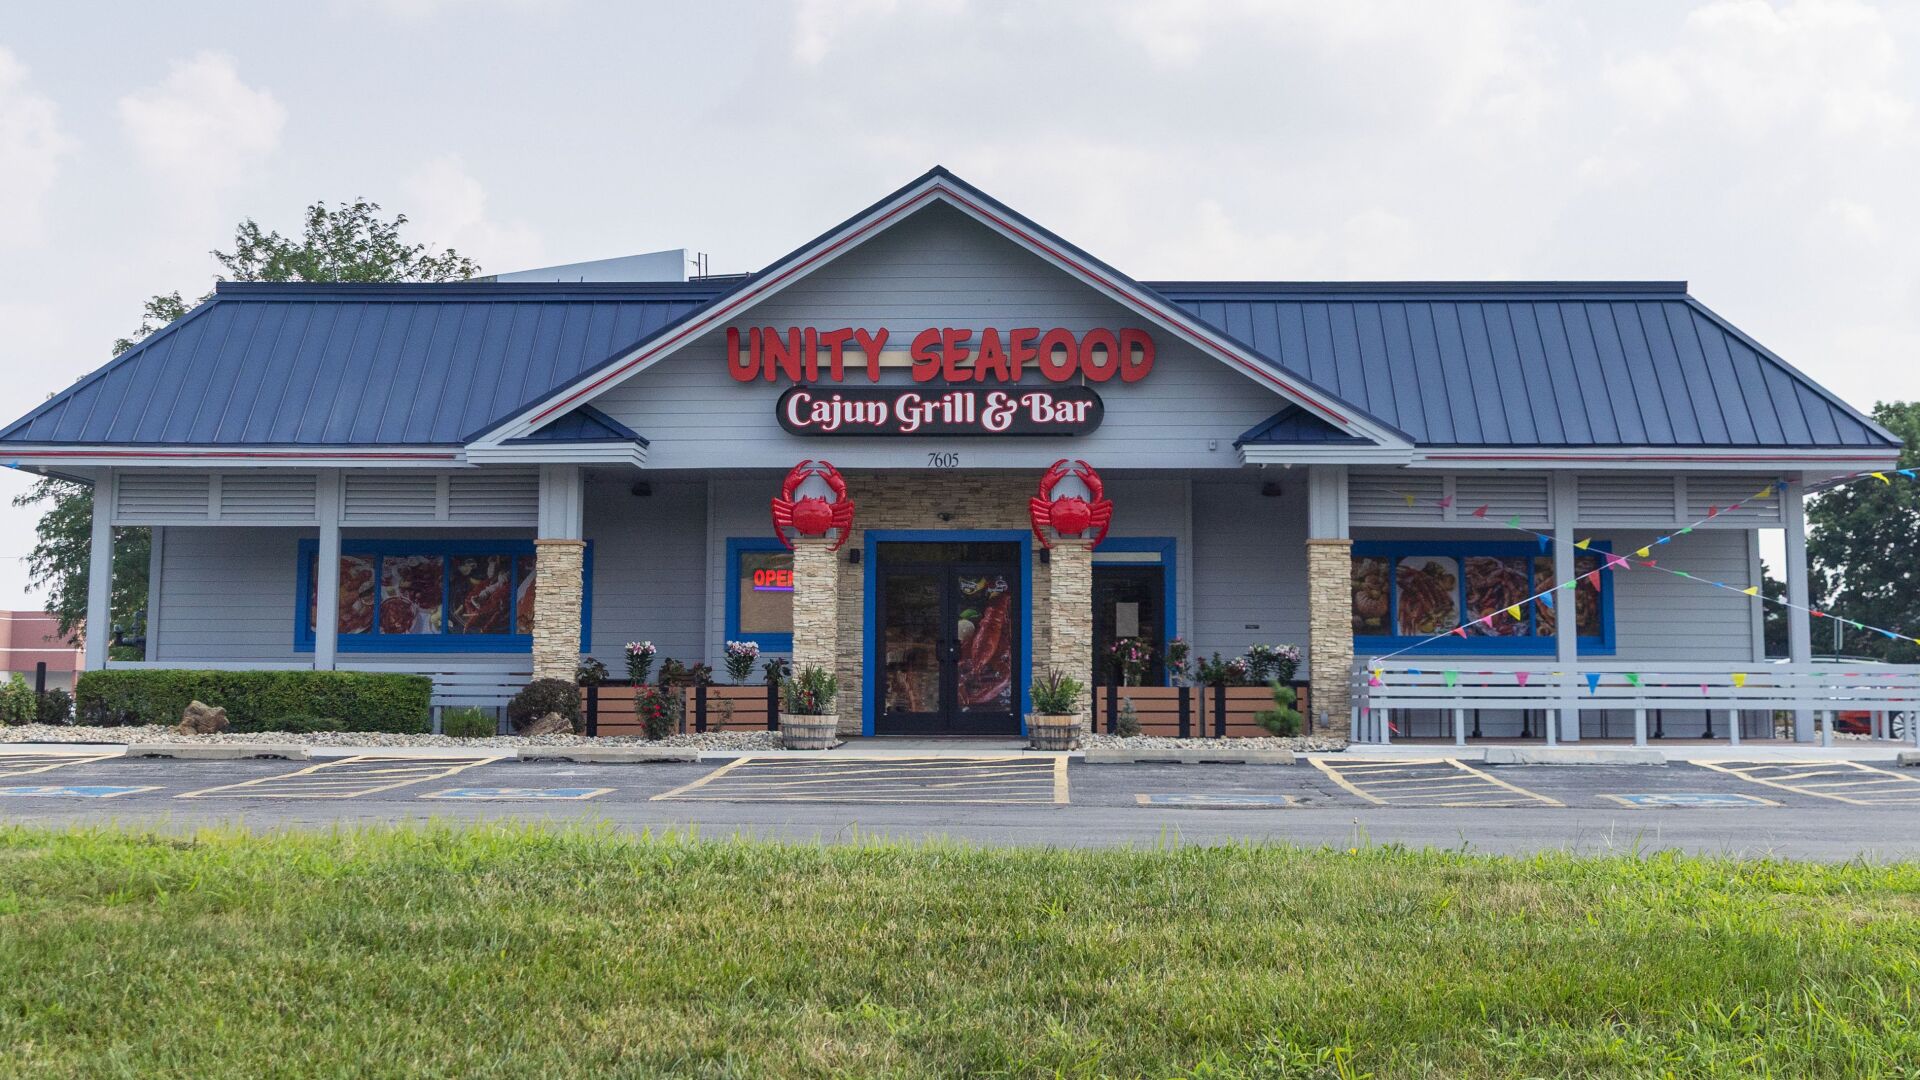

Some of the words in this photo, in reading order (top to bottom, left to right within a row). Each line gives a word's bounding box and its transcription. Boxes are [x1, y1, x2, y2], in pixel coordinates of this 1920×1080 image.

[727, 327, 889, 382] UNITY
[911, 327, 1155, 383] SEAFOOD
[787, 392, 888, 431] Cajun
[895, 392, 976, 432] Grill
[981, 392, 1018, 431] &
[1021, 392, 1092, 423] Bar
[928, 452, 959, 468] 7605
